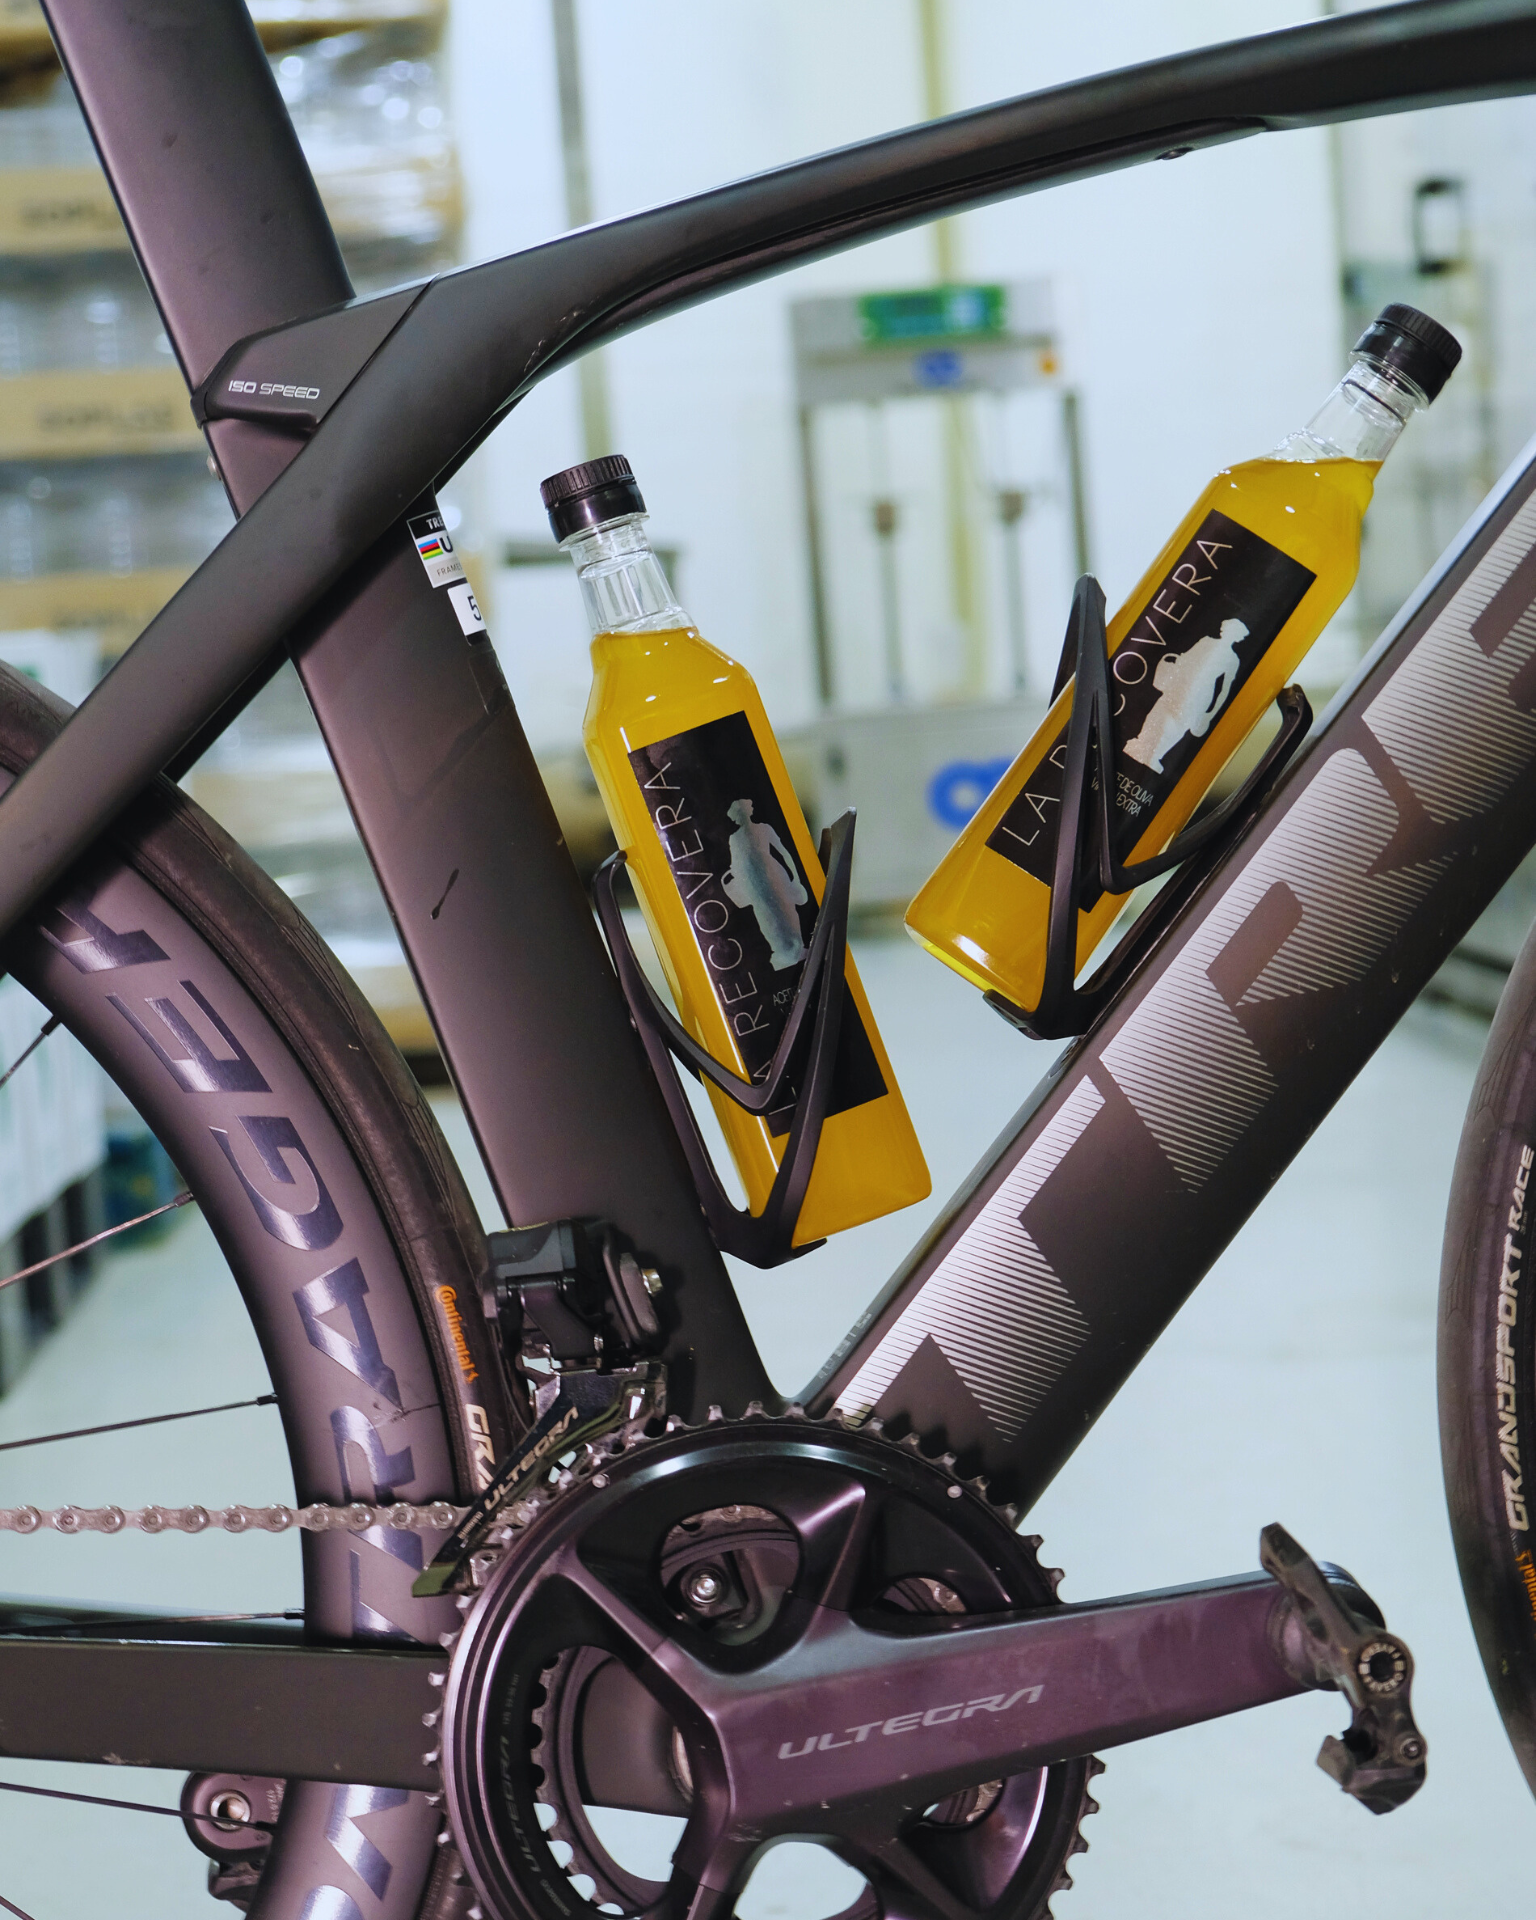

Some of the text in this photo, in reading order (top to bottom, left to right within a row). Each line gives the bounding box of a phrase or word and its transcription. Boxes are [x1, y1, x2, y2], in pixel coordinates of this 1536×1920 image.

[228, 380, 320, 400] ISO SPEED
[467, 595, 482, 621] 5
[1001, 790, 1061, 847] LA
[643, 761, 770, 1038] RECOVERA
[435, 1285, 476, 1372] Continental
[1496, 1144, 1535, 1532] GRANDSPORT RACE
[484, 1406, 579, 1511] ULTEGRA
[777, 1684, 1045, 1760] ULTEGRA
[500, 1735, 541, 1874] ULTEGRA
